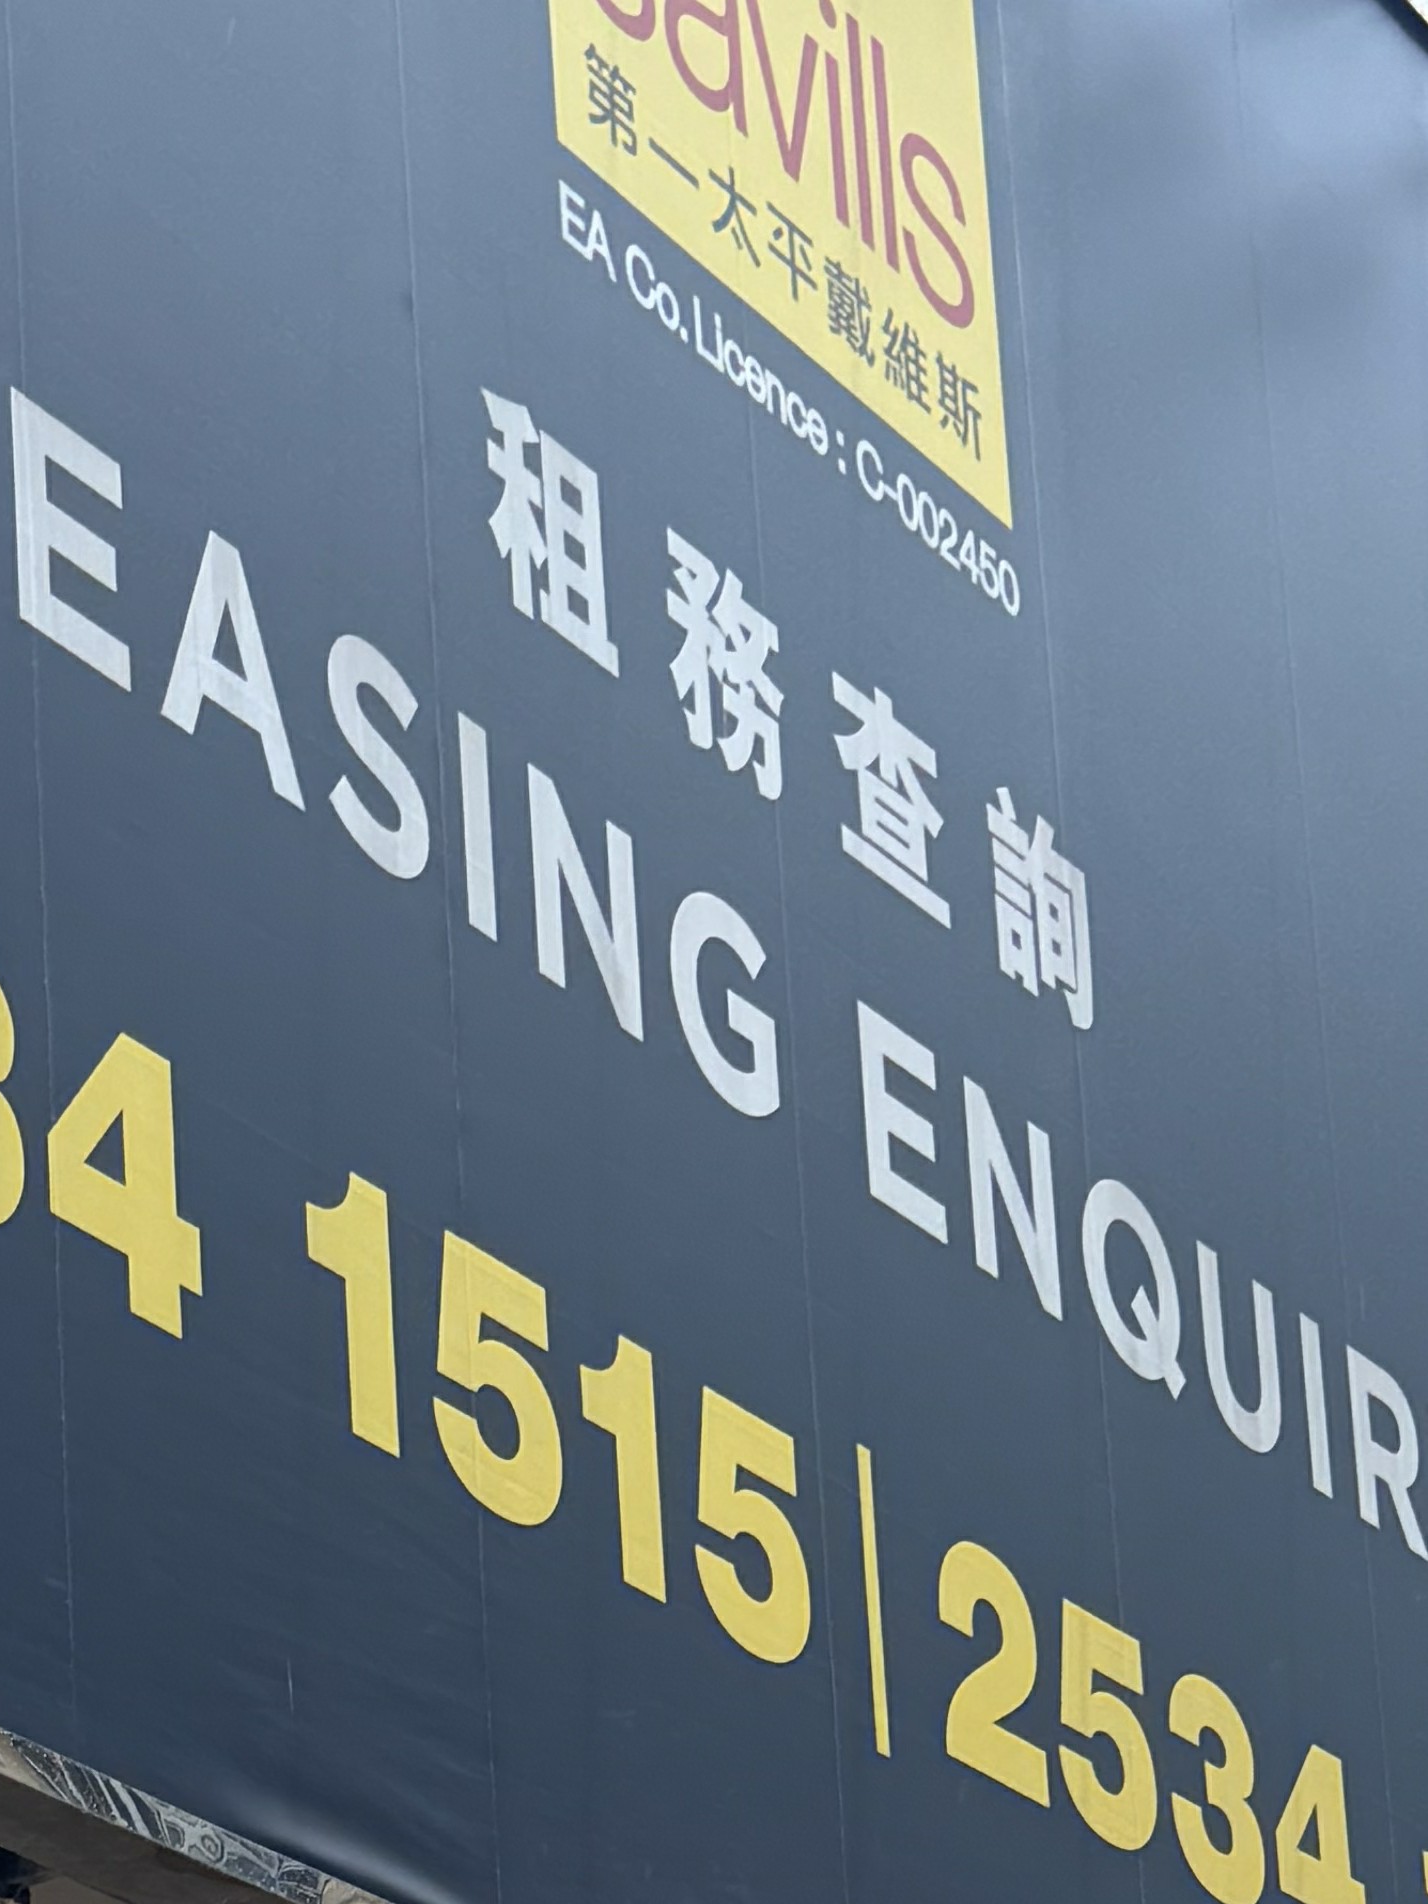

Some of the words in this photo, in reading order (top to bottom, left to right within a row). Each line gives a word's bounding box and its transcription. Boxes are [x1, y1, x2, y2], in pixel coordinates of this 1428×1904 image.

[584, 44, 981, 461] 第一太平戴維斯
[594, 0, 975, 328] avills
[558, 179, 616, 283] EA
[856, 440, 1020, 617] C-002450
[480, 386, 1093, 1030] 租務查詢
[306, 1173, 810, 1663] 1515
[857, 1000, 1428, 1561] ENQUIR
